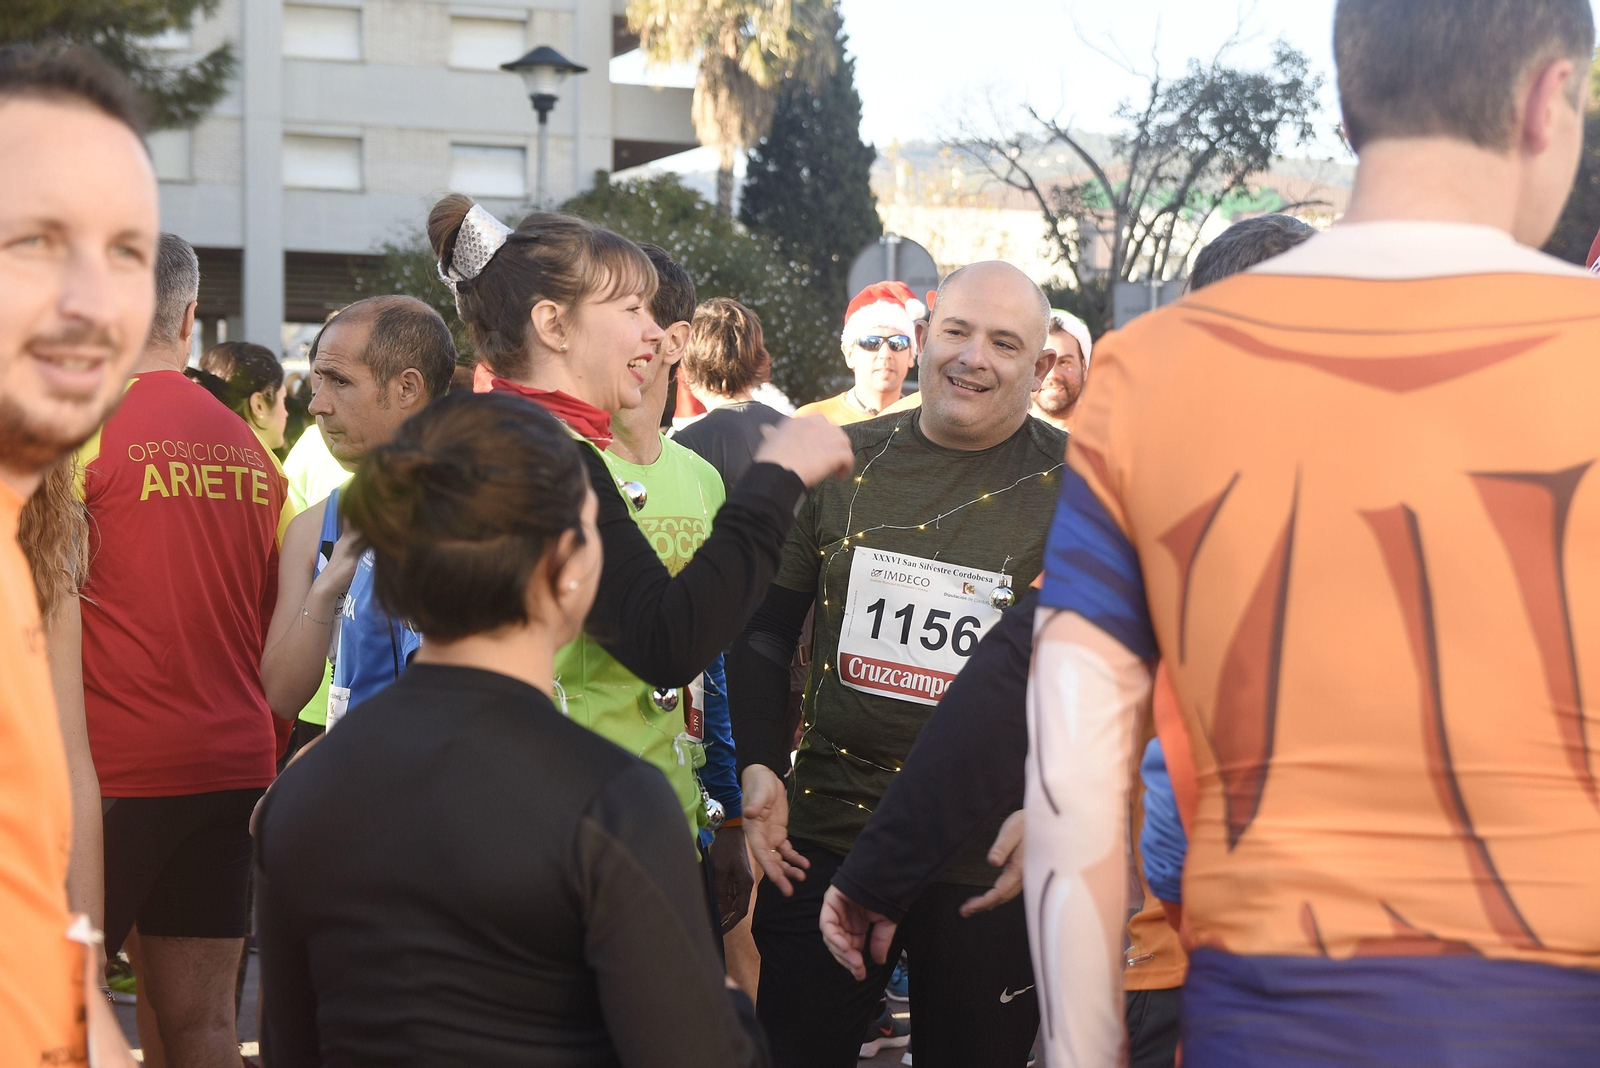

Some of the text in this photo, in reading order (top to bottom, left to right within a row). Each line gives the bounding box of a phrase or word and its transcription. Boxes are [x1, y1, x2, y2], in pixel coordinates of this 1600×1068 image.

[128, 440, 265, 468] OPOSICIONES
[139, 461, 269, 506] ARIETE
[872, 553, 994, 584] XXXVI San Silvestre Cordobesa
[883, 570, 931, 588] IMDECO
[866, 597, 982, 657] 1156
